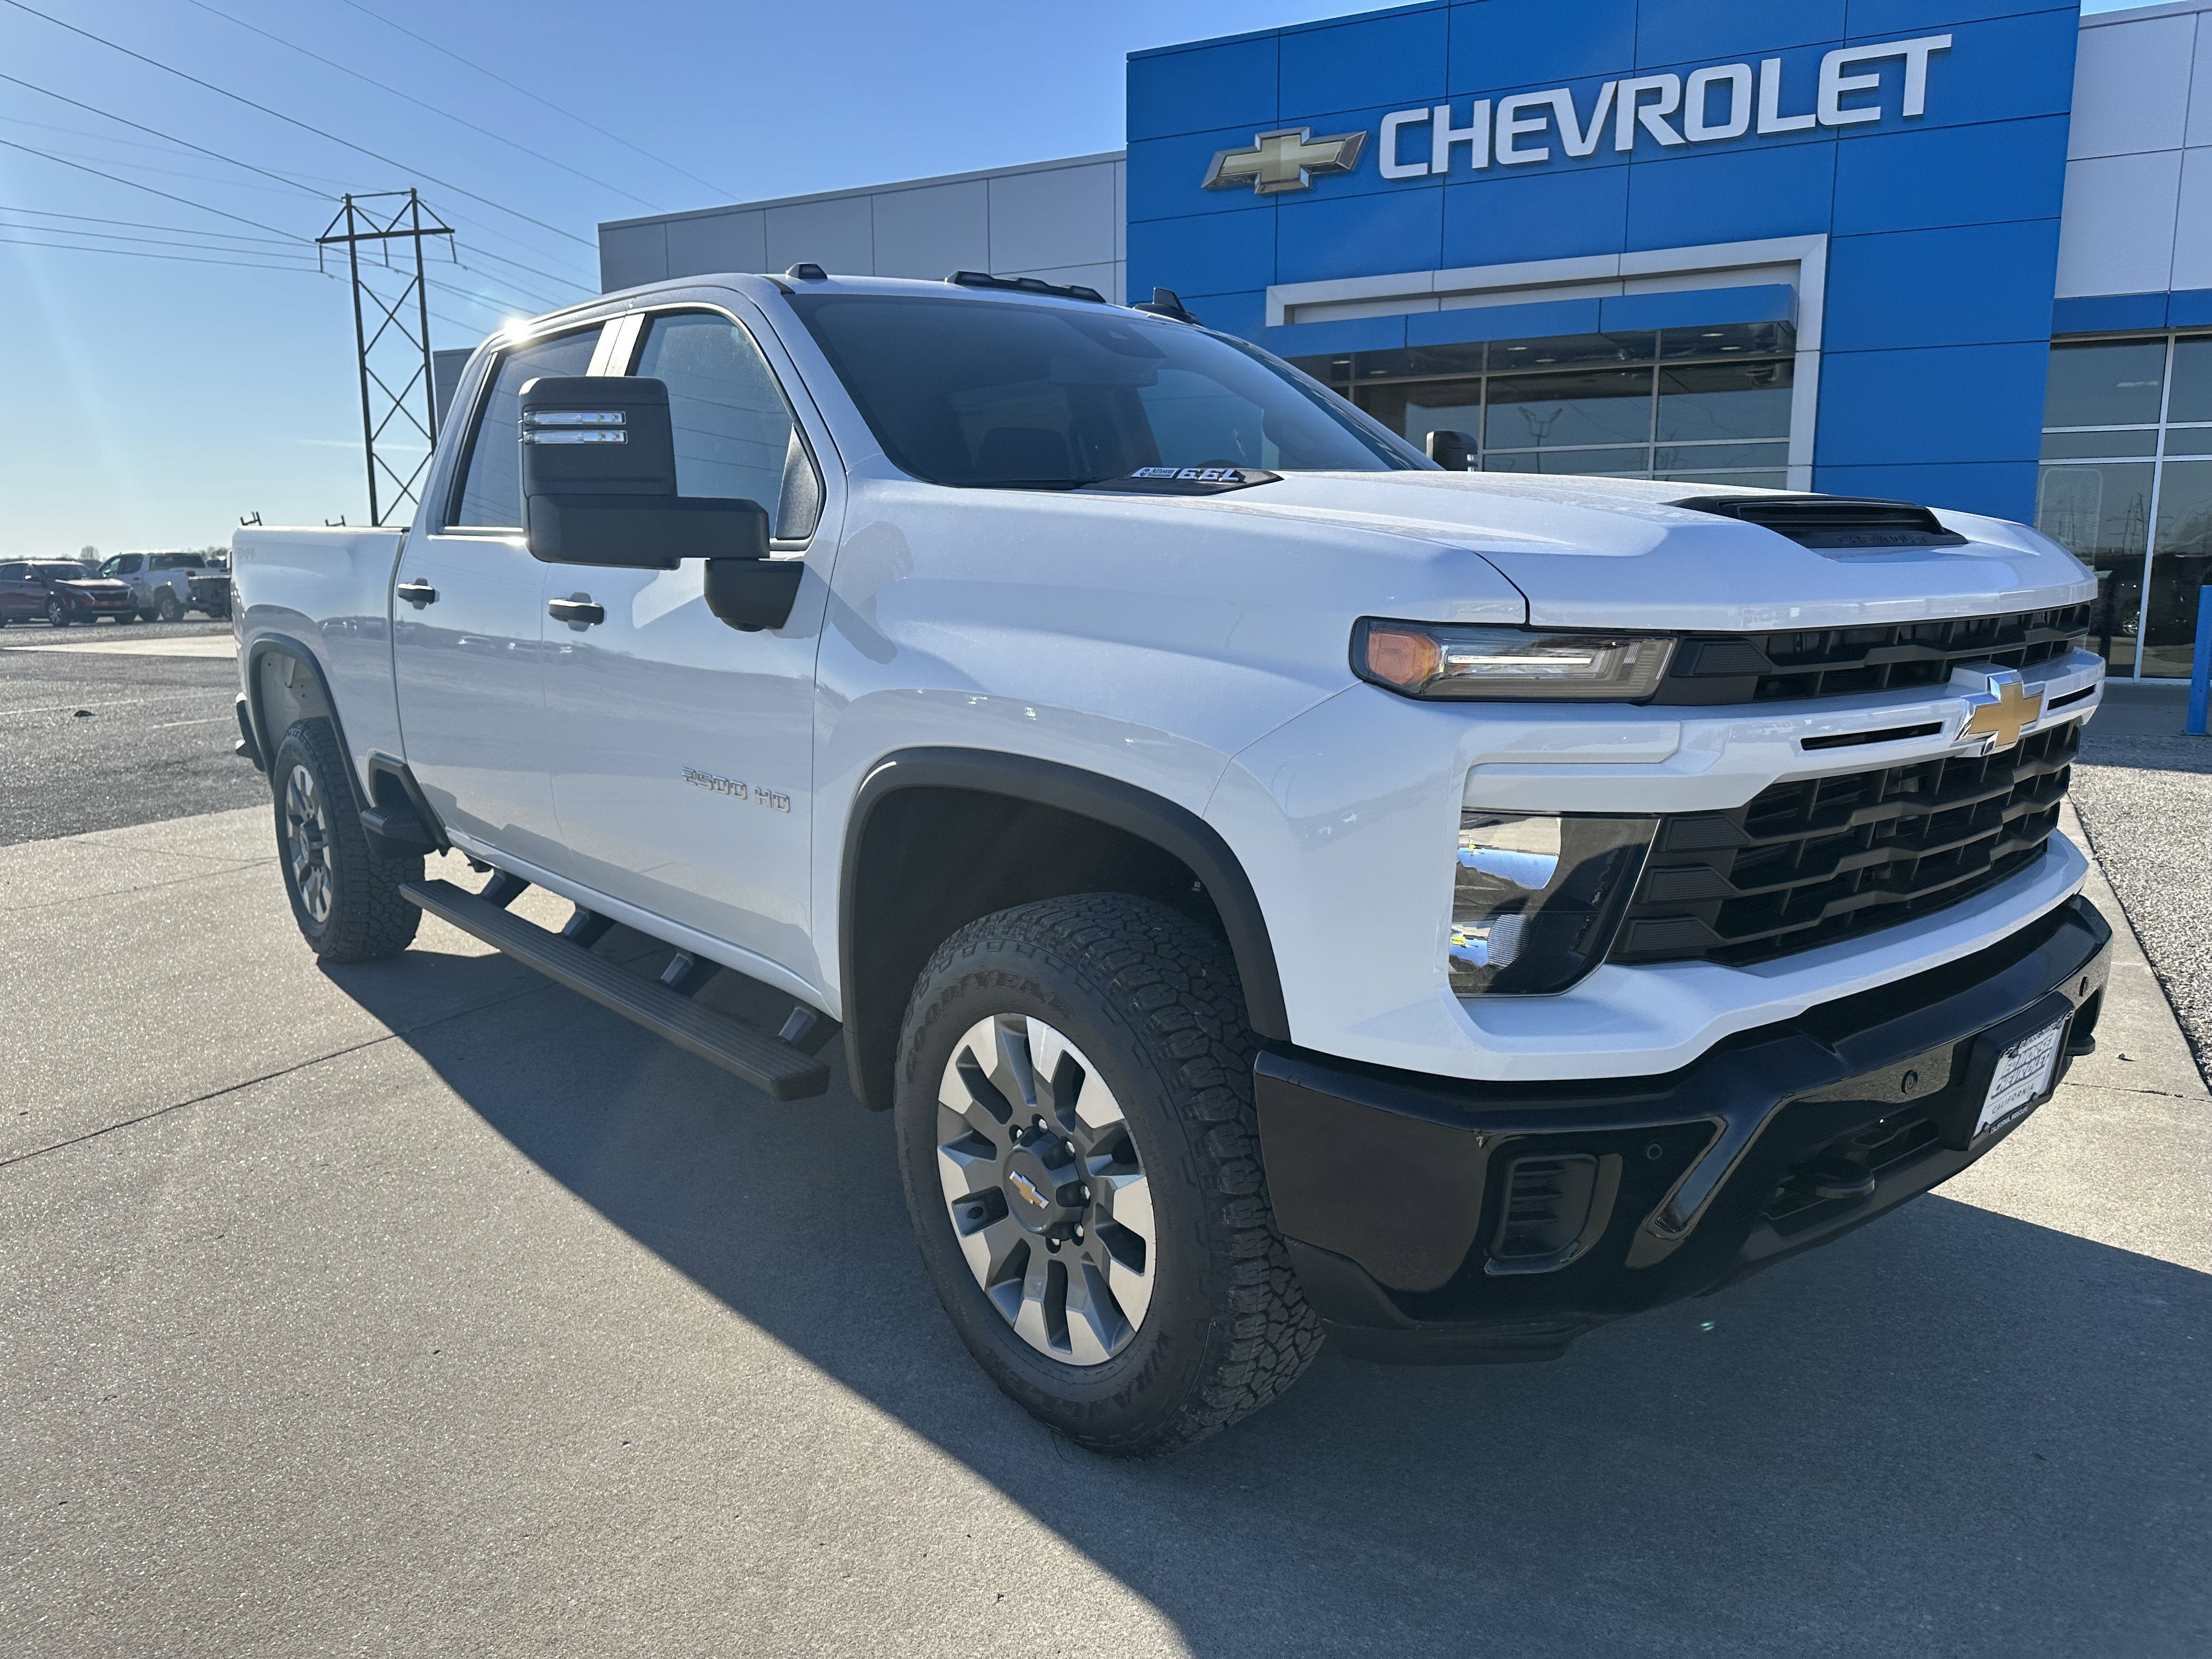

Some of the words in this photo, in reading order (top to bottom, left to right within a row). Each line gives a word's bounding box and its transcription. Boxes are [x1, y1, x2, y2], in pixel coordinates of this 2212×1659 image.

[1378, 33, 1953, 180] CHEVROLET
[681, 766, 747, 800] 2500
[754, 786, 790, 813] HD
[906, 970, 1075, 1084] GOODYEAR
[1991, 1047, 2052, 1099] CHEVROLET
[2002, 1054, 2020, 1075] ED
[2016, 1033, 2053, 1068] MORSE
[1992, 1083, 2033, 1114] CALIFORNIA
